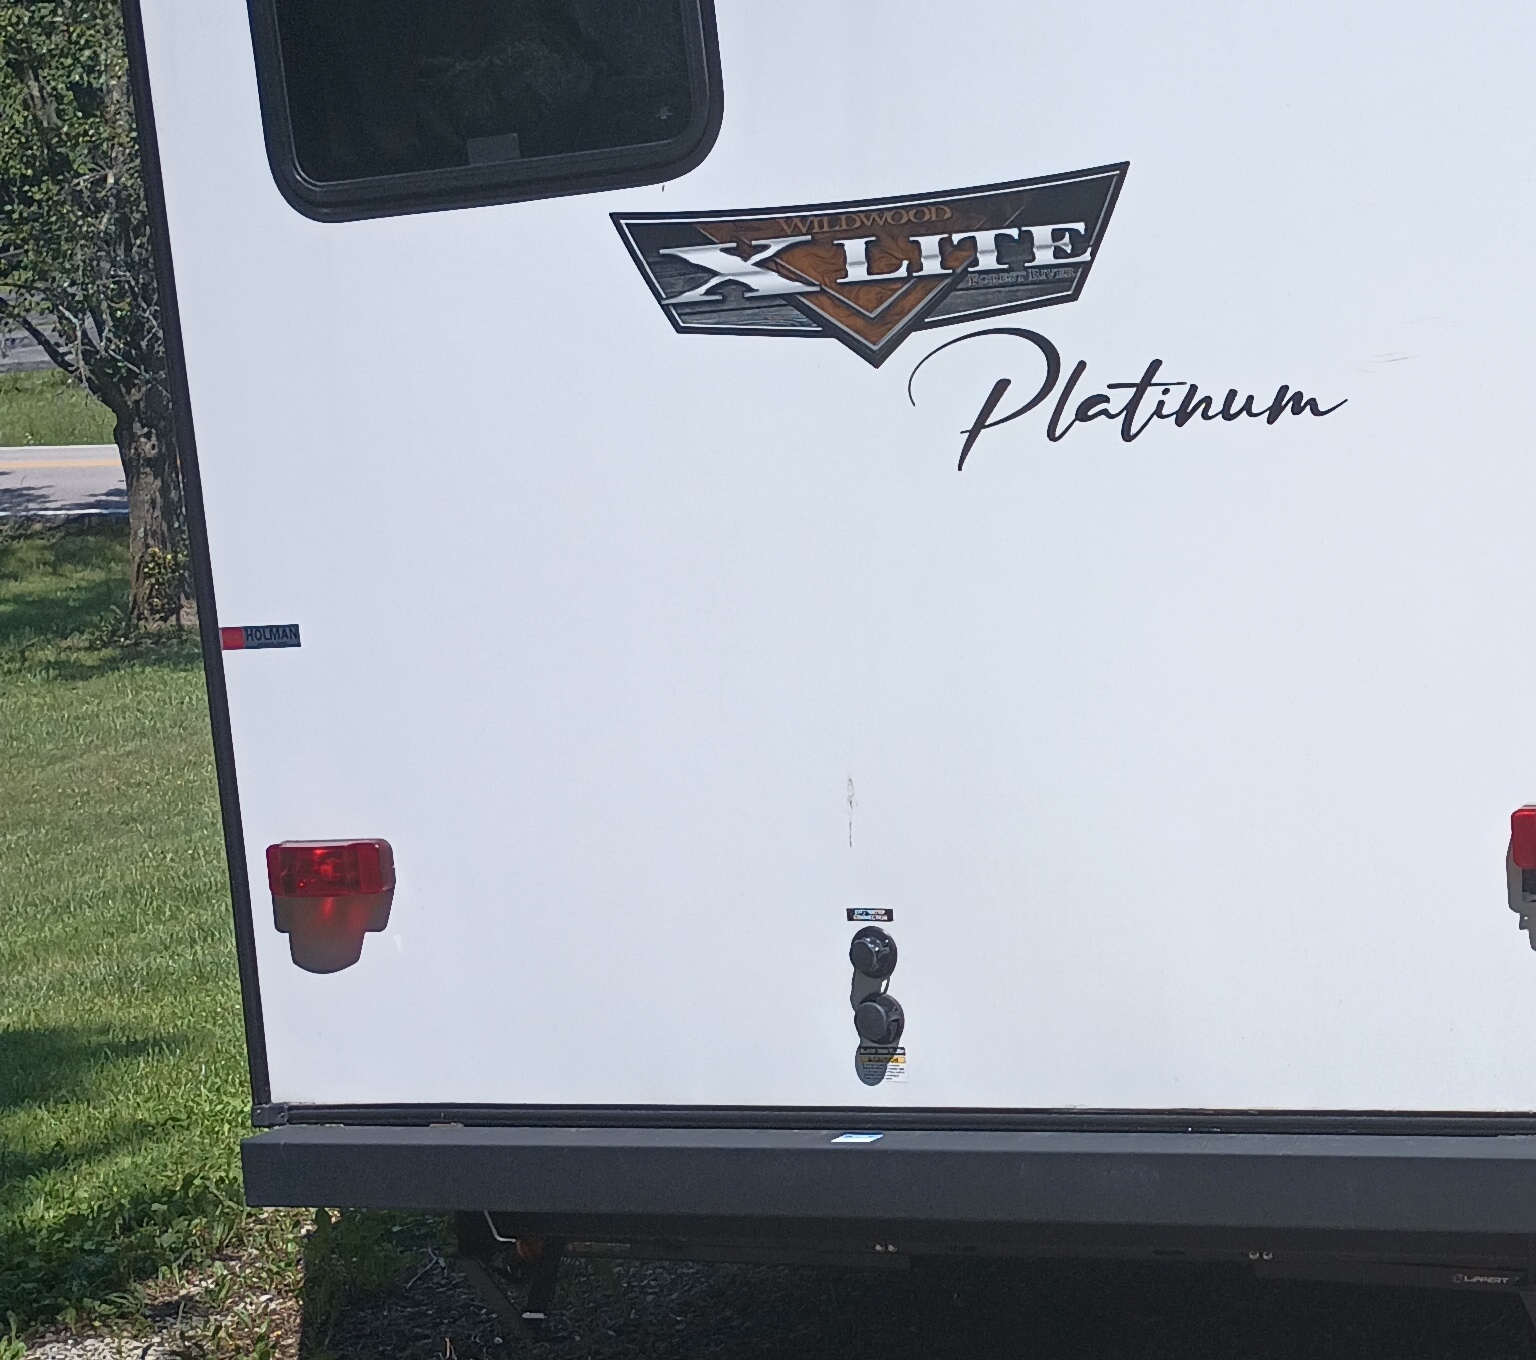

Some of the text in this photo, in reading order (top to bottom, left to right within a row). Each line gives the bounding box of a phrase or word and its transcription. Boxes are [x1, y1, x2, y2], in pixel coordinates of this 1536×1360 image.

[775, 205, 953, 236] WILDWOOD
[908, 327, 1348, 472] Platinum
[246, 626, 298, 642] HOLMAN
